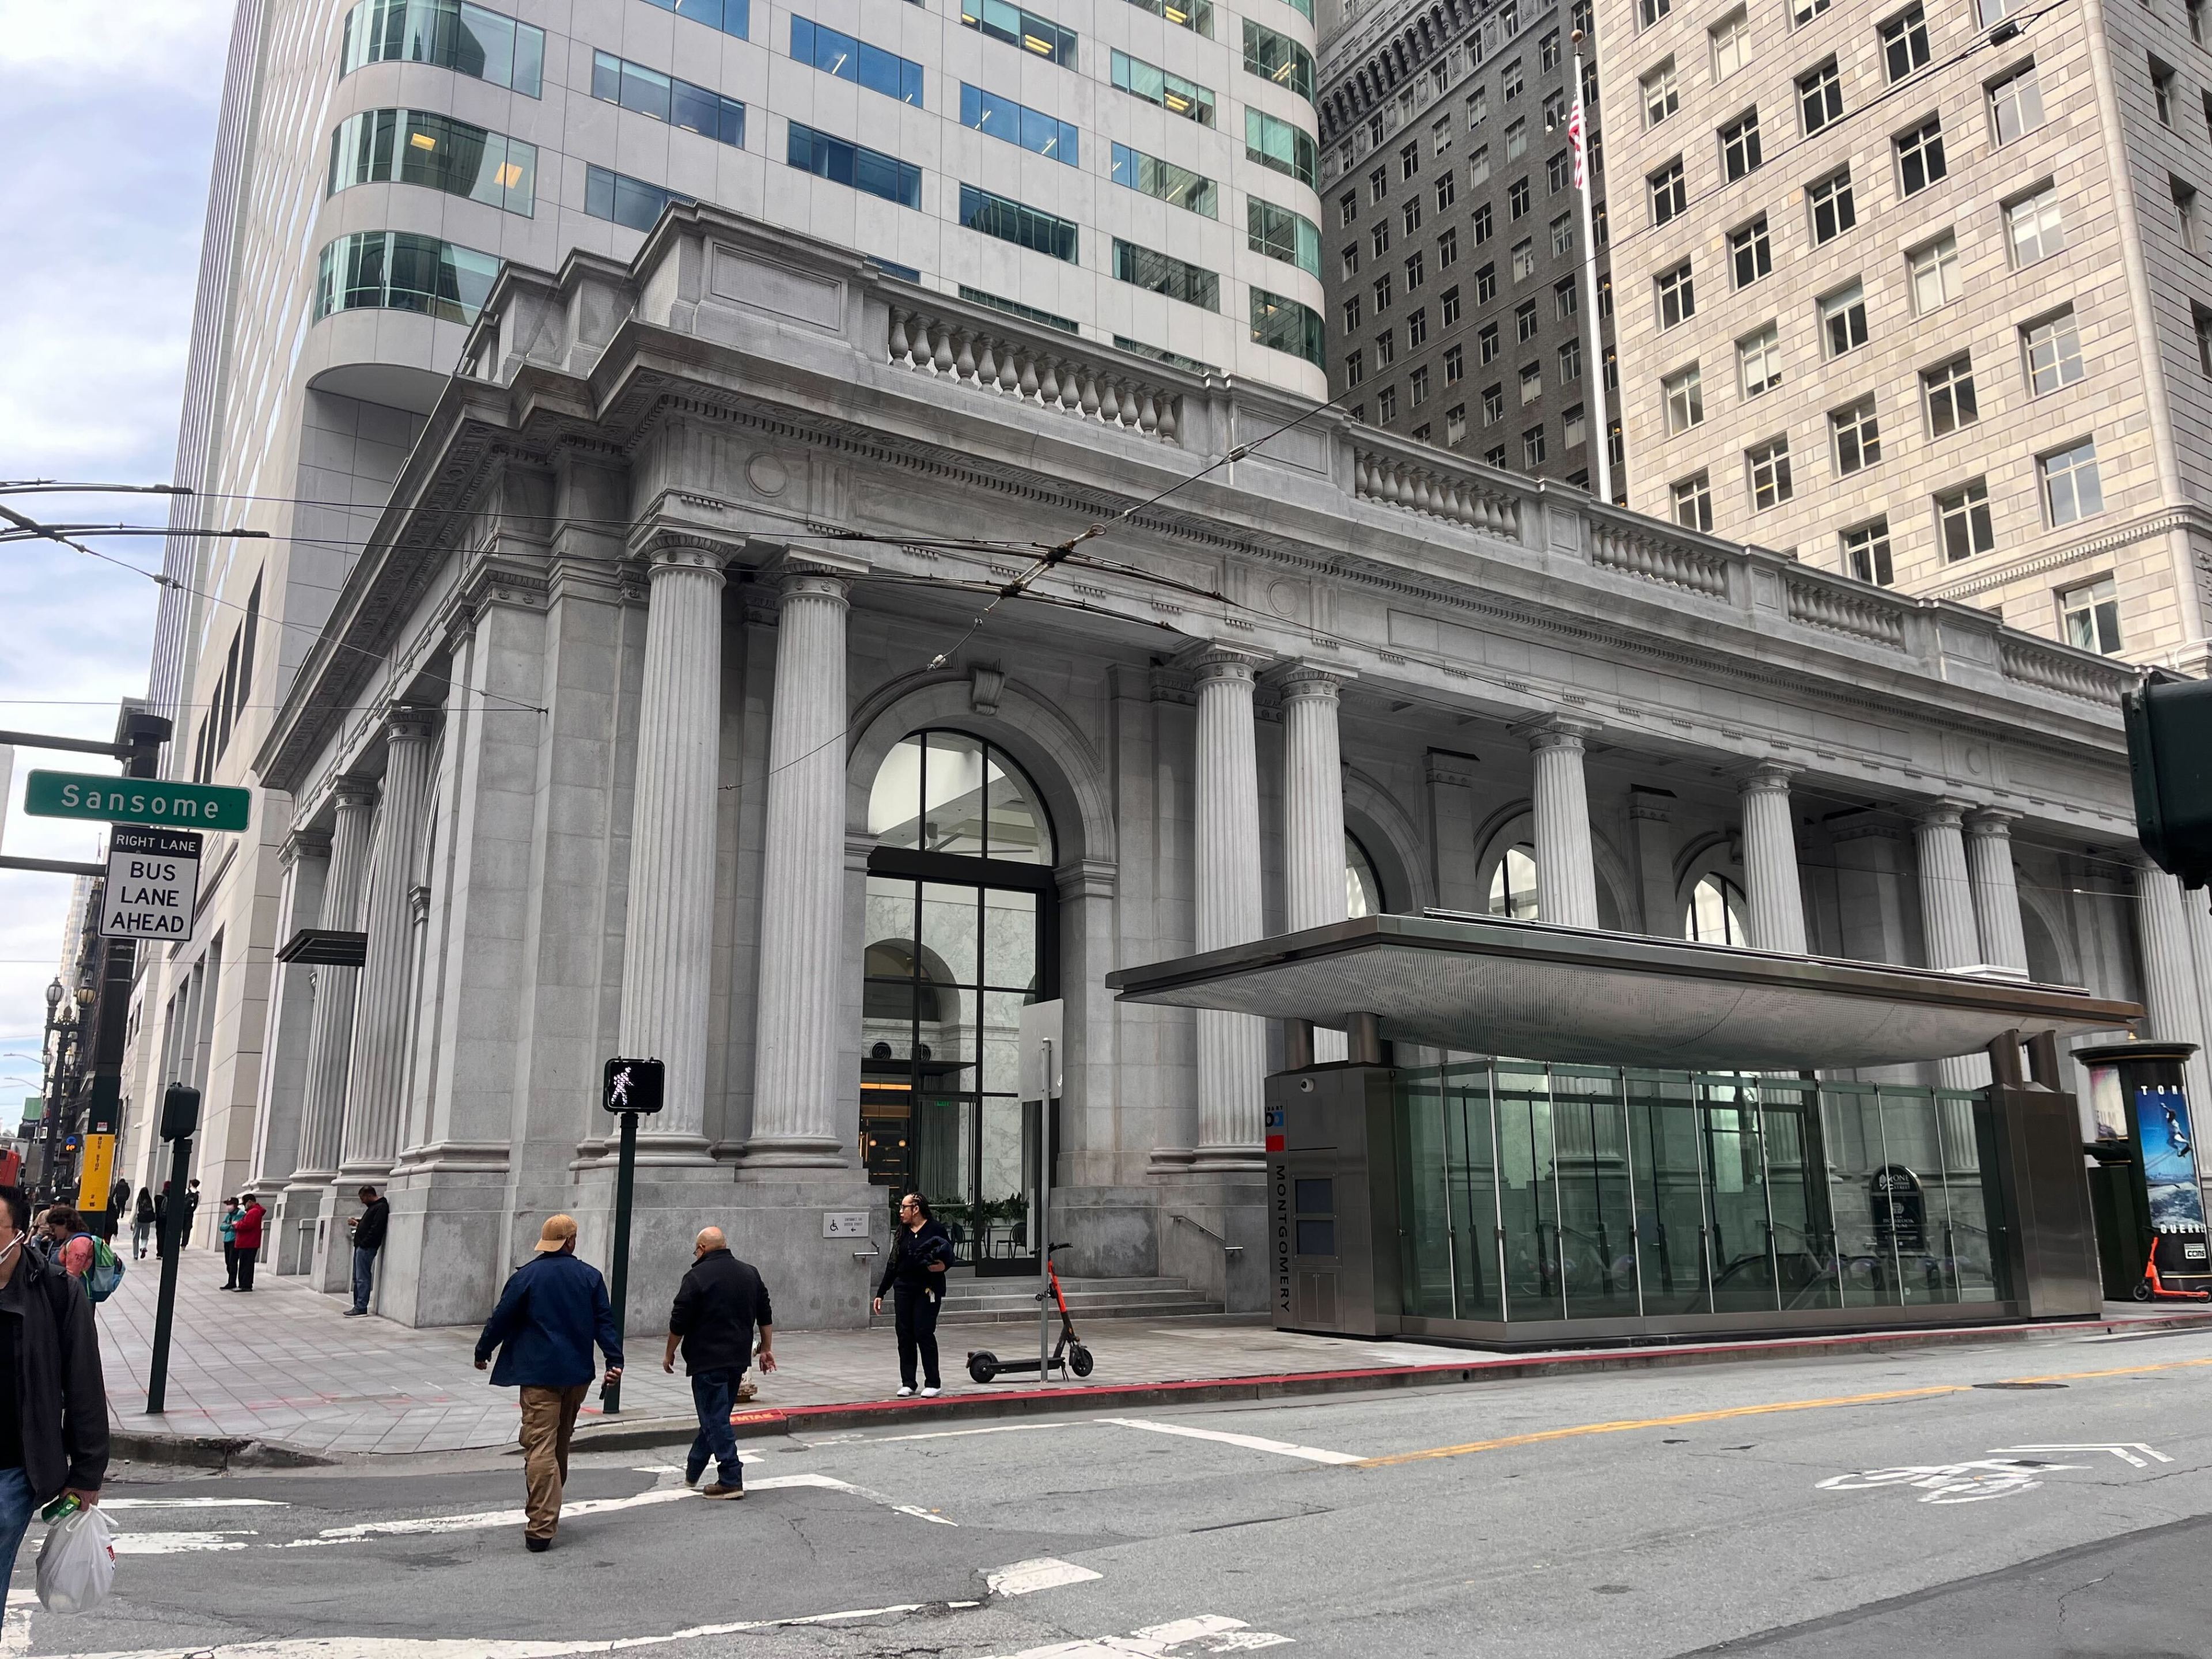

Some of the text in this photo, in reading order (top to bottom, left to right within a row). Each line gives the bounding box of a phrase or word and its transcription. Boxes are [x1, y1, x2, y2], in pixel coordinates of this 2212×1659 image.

[61, 784, 219, 819] Sansome
[116, 834, 196, 852] RIGHT LANE
[130, 861, 176, 881] BUS
[120, 886, 180, 907] LANE
[111, 911, 184, 933] AHEAD
[1276, 1165, 1290, 1313] MONTGOMERY
